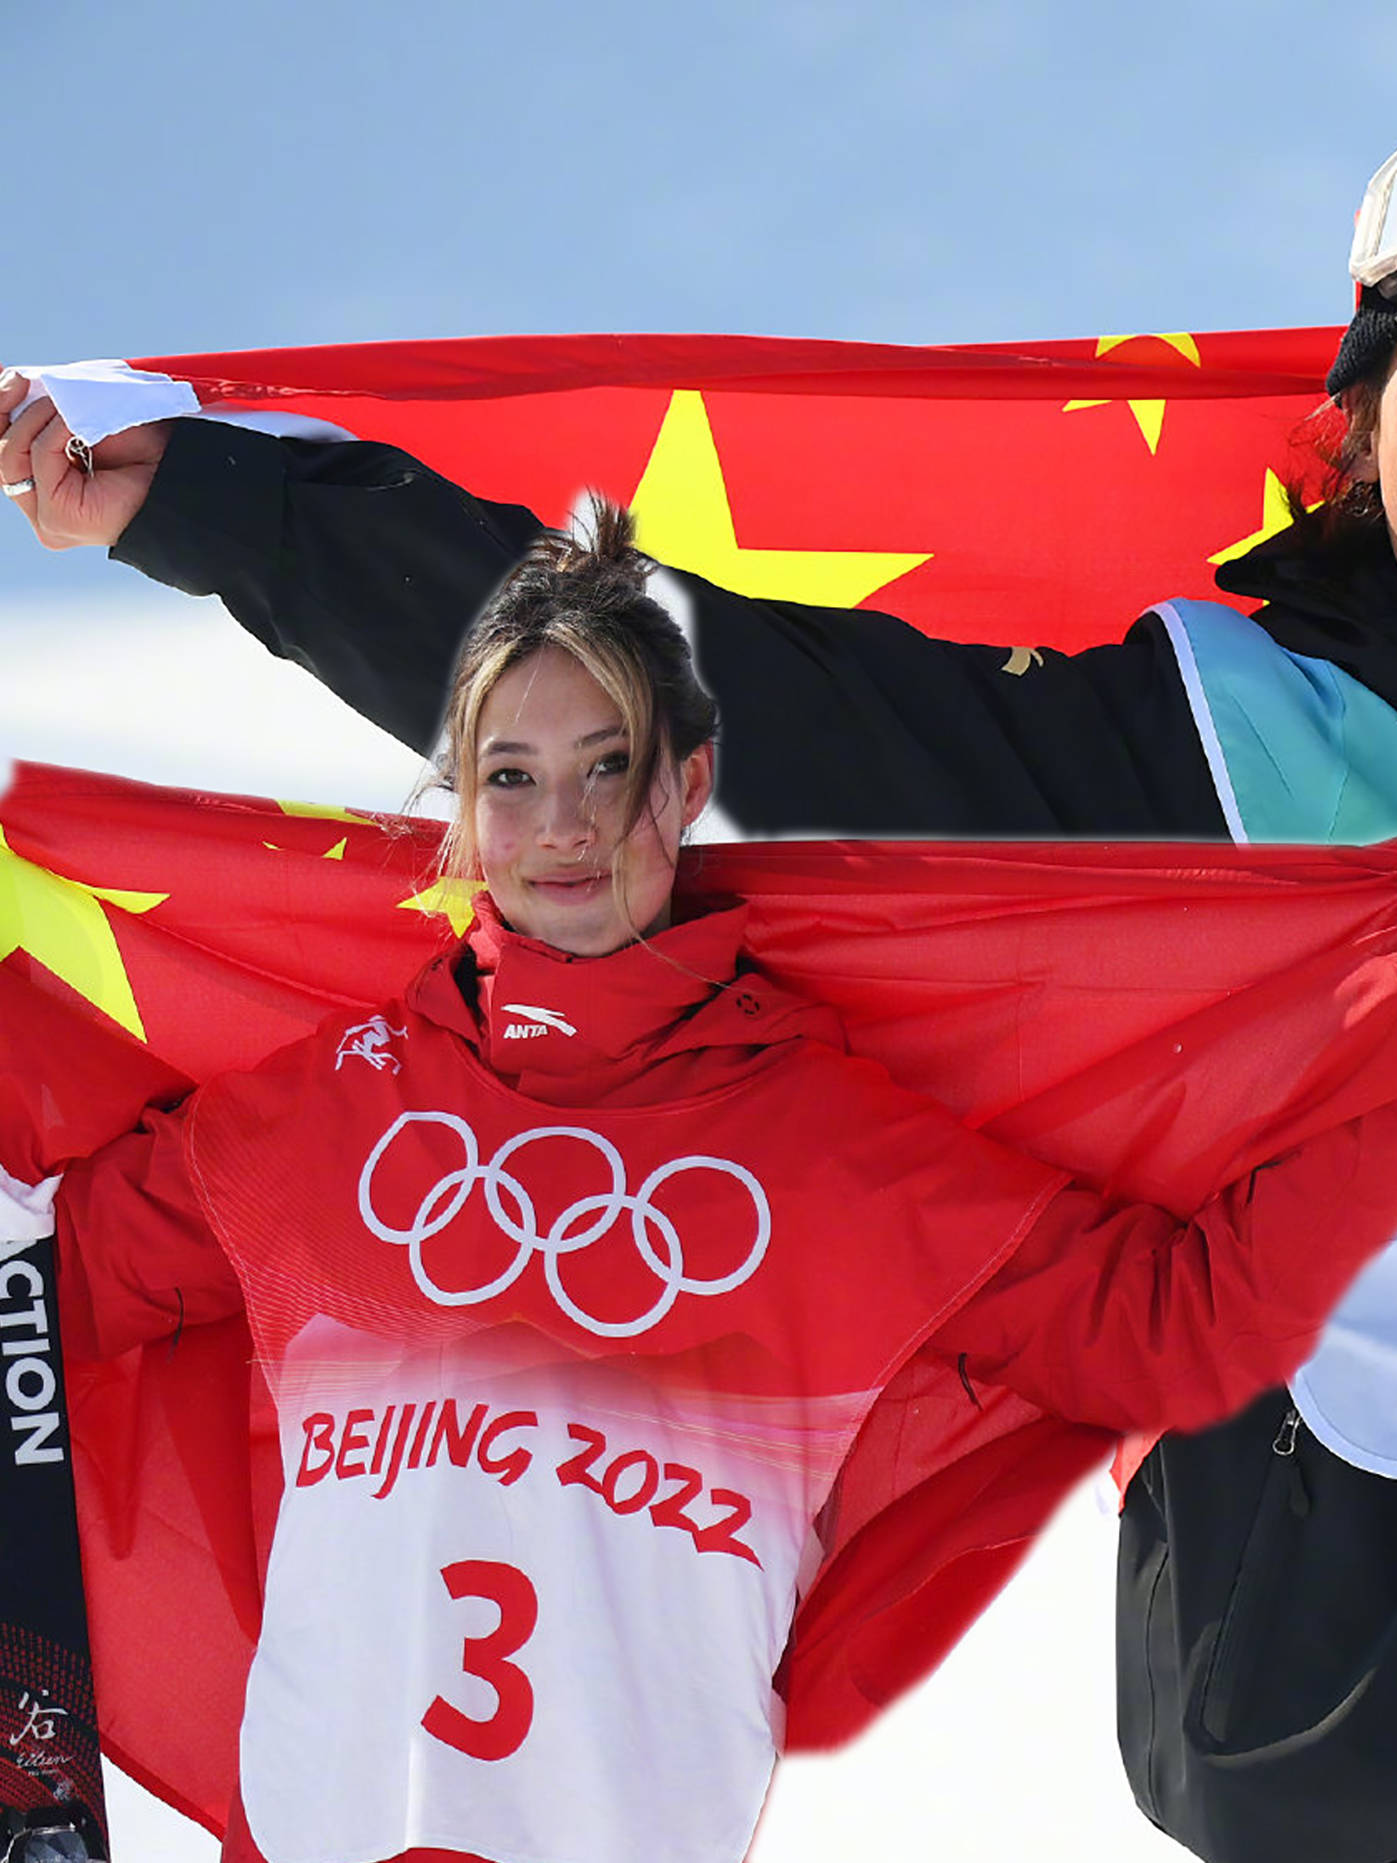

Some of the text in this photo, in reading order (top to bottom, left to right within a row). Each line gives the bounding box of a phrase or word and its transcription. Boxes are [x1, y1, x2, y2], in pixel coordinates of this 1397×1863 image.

[503, 1024, 548, 1039] ANTA
[296, 1398, 765, 1573] BEIJING 2022
[421, 1559, 539, 1762] 3
